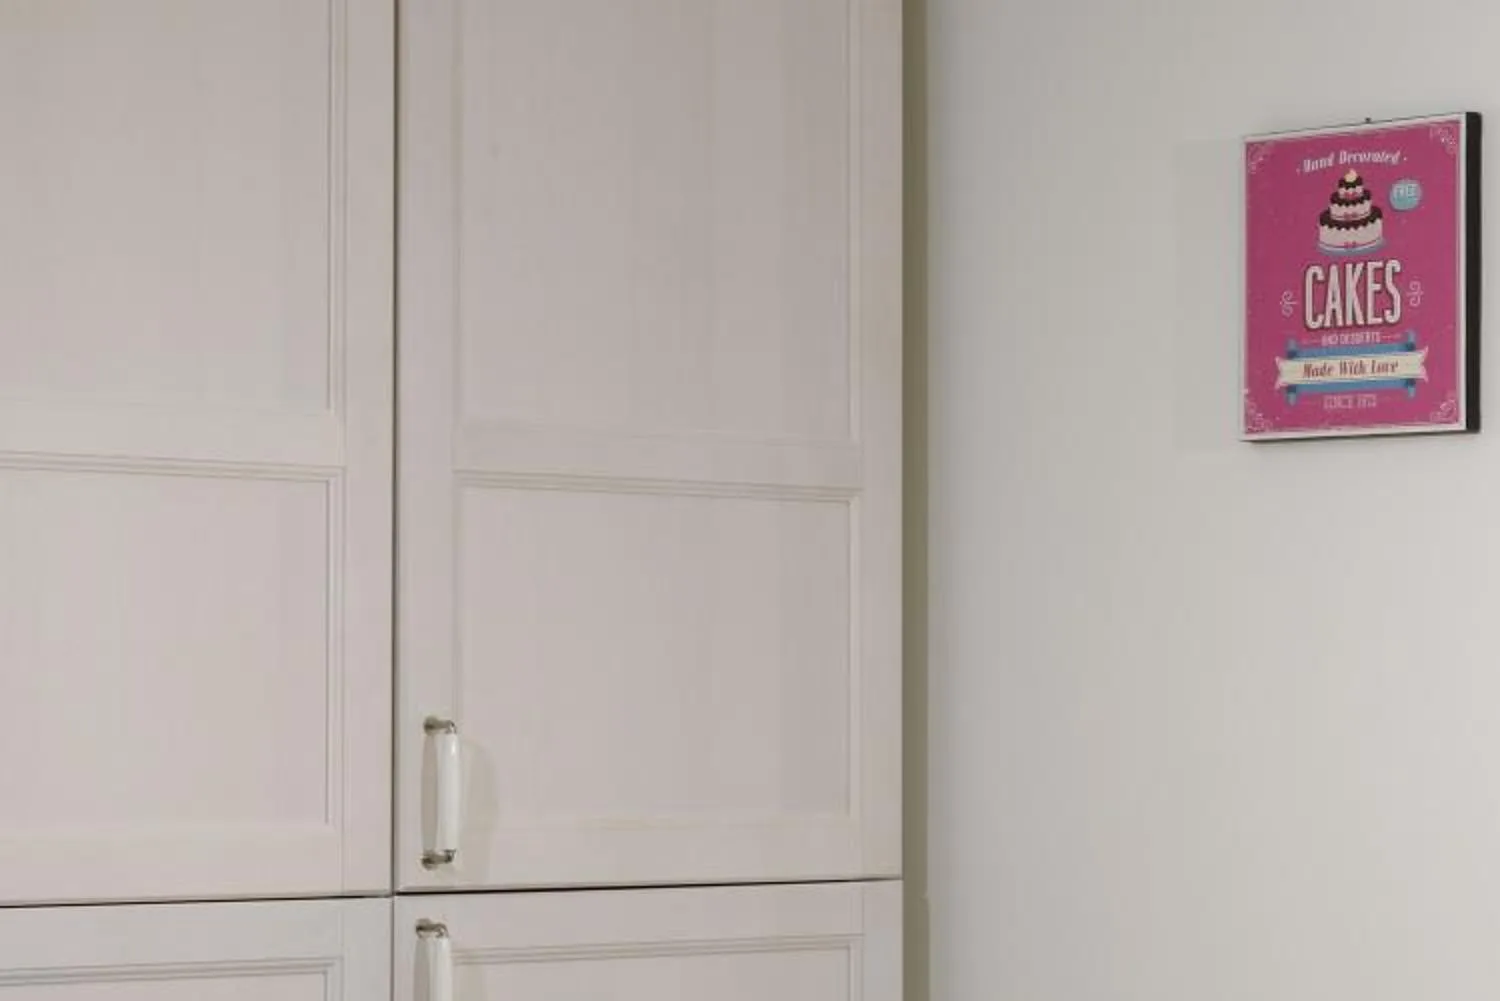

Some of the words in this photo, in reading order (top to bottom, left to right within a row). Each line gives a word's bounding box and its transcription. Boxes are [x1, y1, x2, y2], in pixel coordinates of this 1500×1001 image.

[1303, 151, 1335, 172] Hand
[1339, 150, 1401, 165] Decorated
[1304, 258, 1402, 330] CAKES
[1303, 361, 1334, 378] Made
[1339, 359, 1367, 376] With
